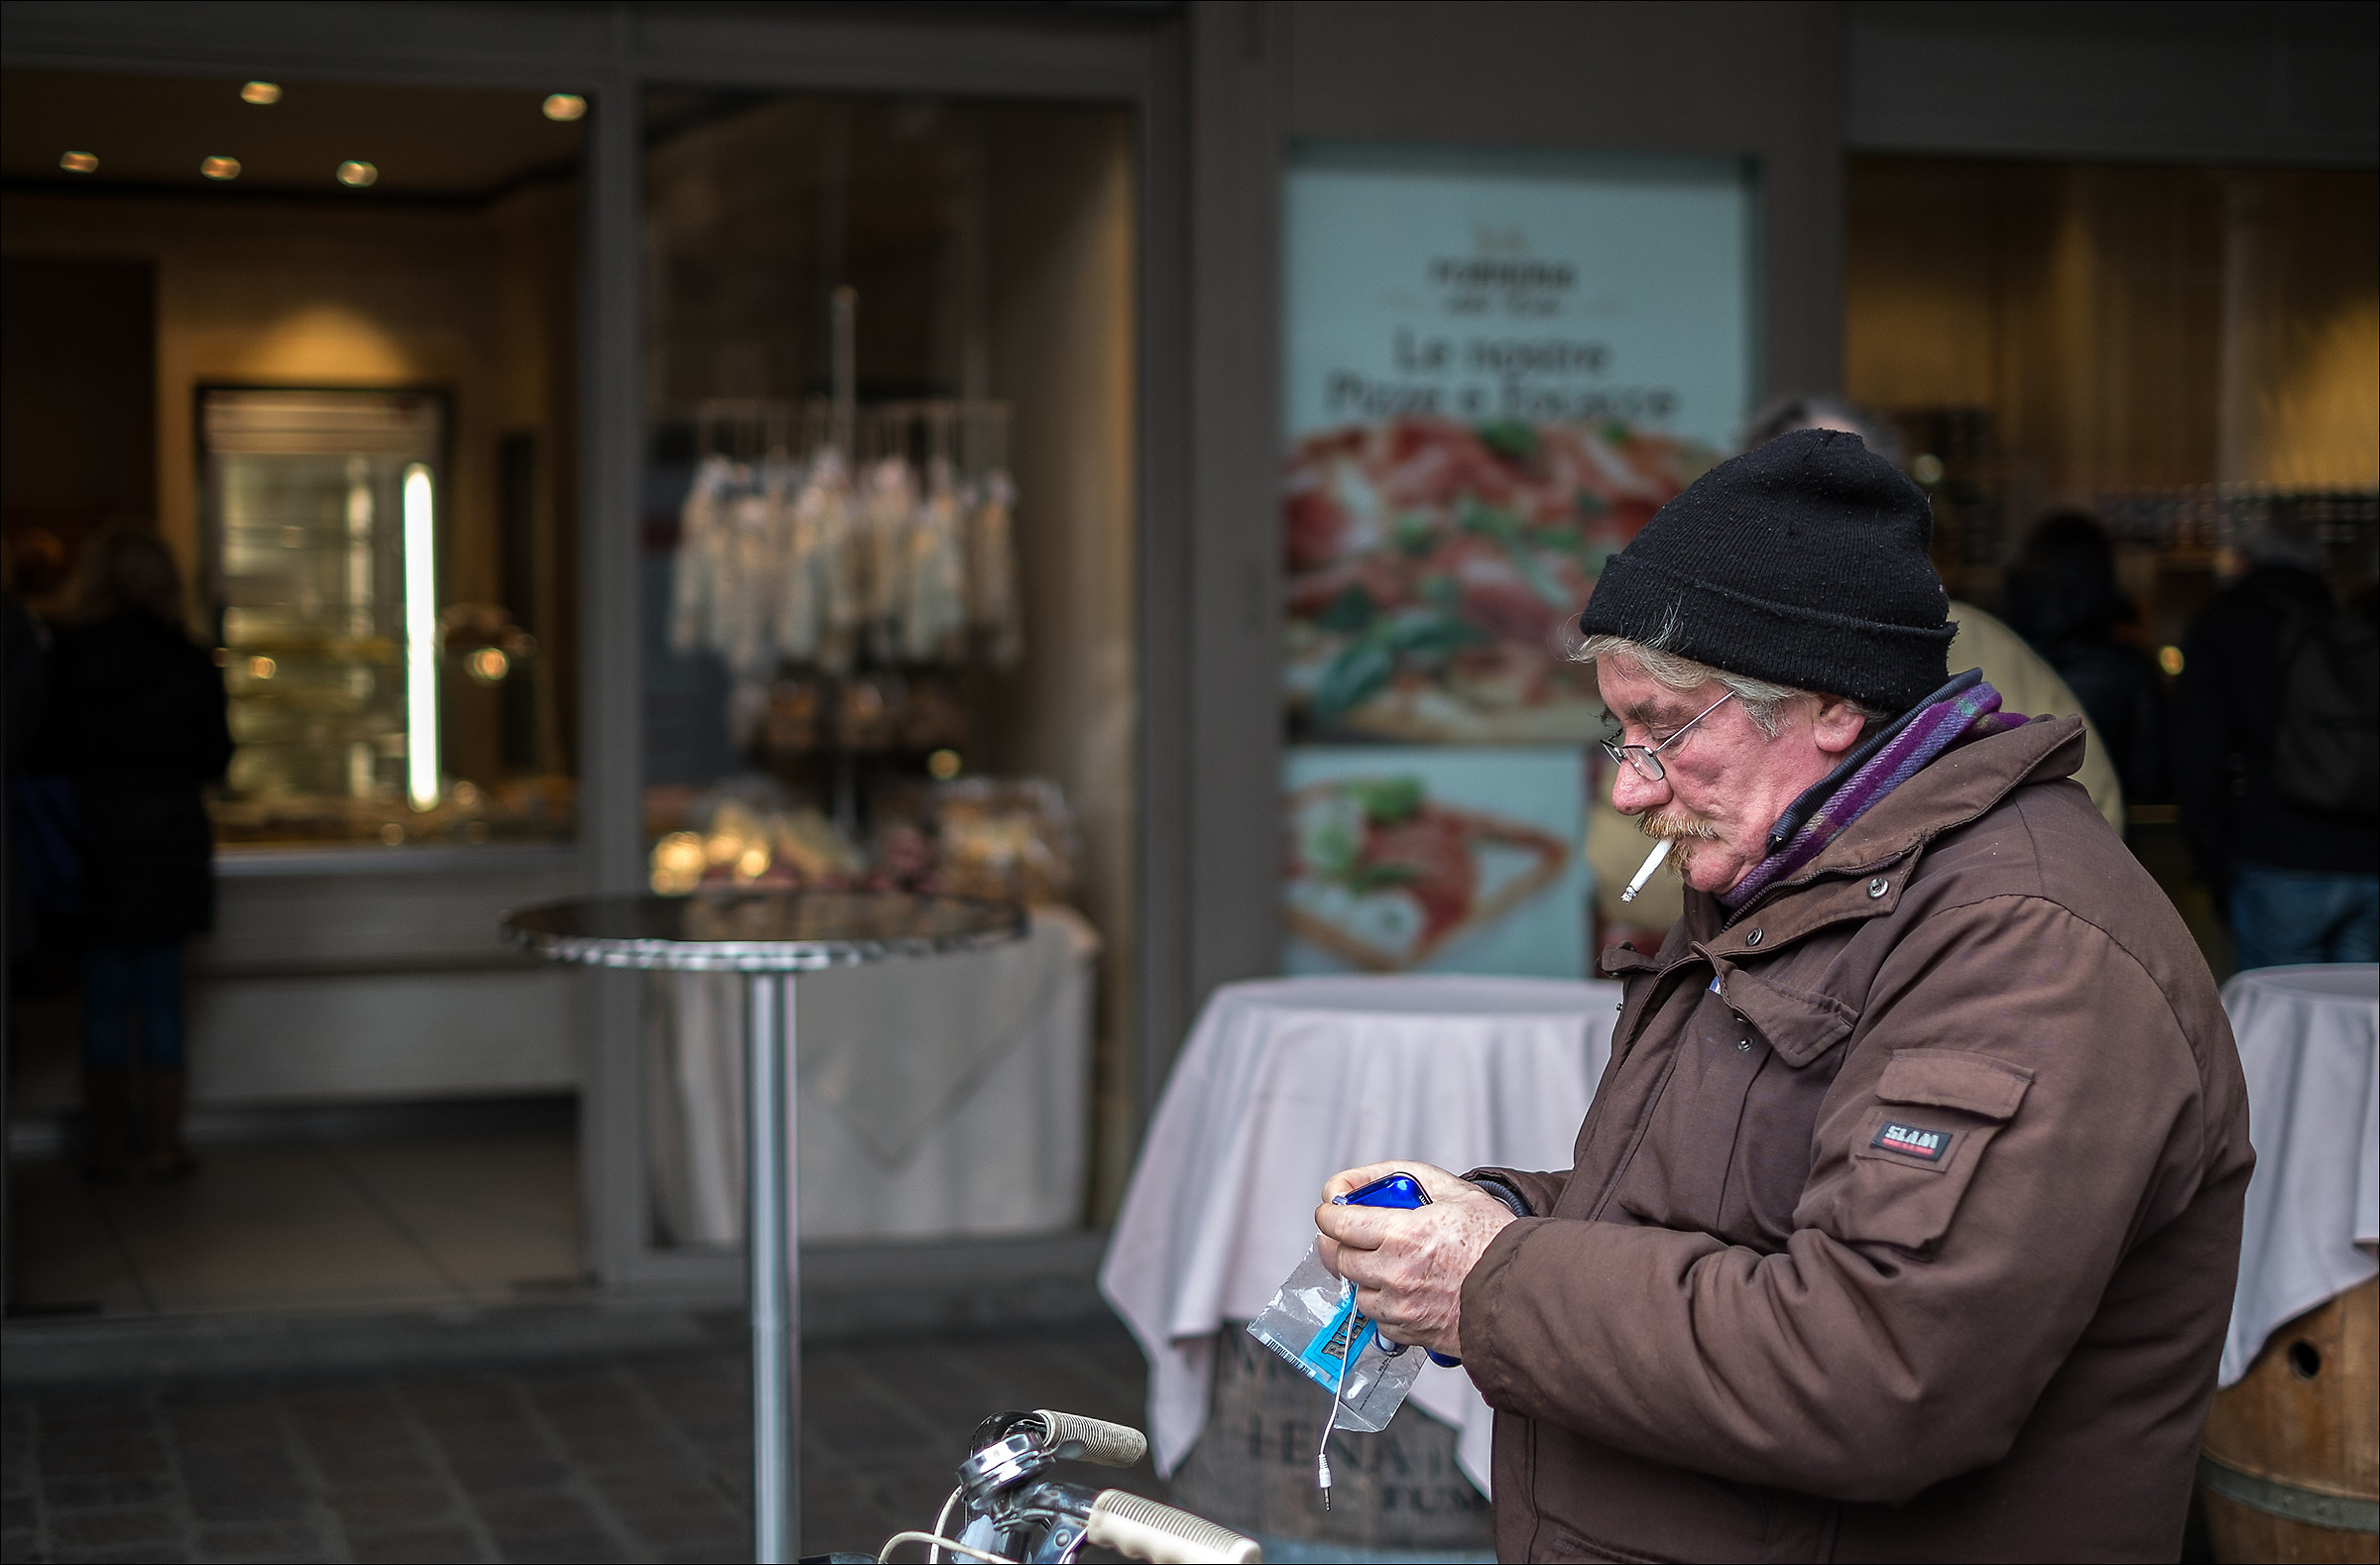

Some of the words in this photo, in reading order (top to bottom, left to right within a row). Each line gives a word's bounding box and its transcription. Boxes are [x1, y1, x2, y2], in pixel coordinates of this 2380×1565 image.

[1394, 325, 1450, 372] Le
[1467, 338, 1610, 373] nostre
[1885, 1126, 1939, 1149] SLAM
[1321, 1312, 1370, 1360] RIZL
